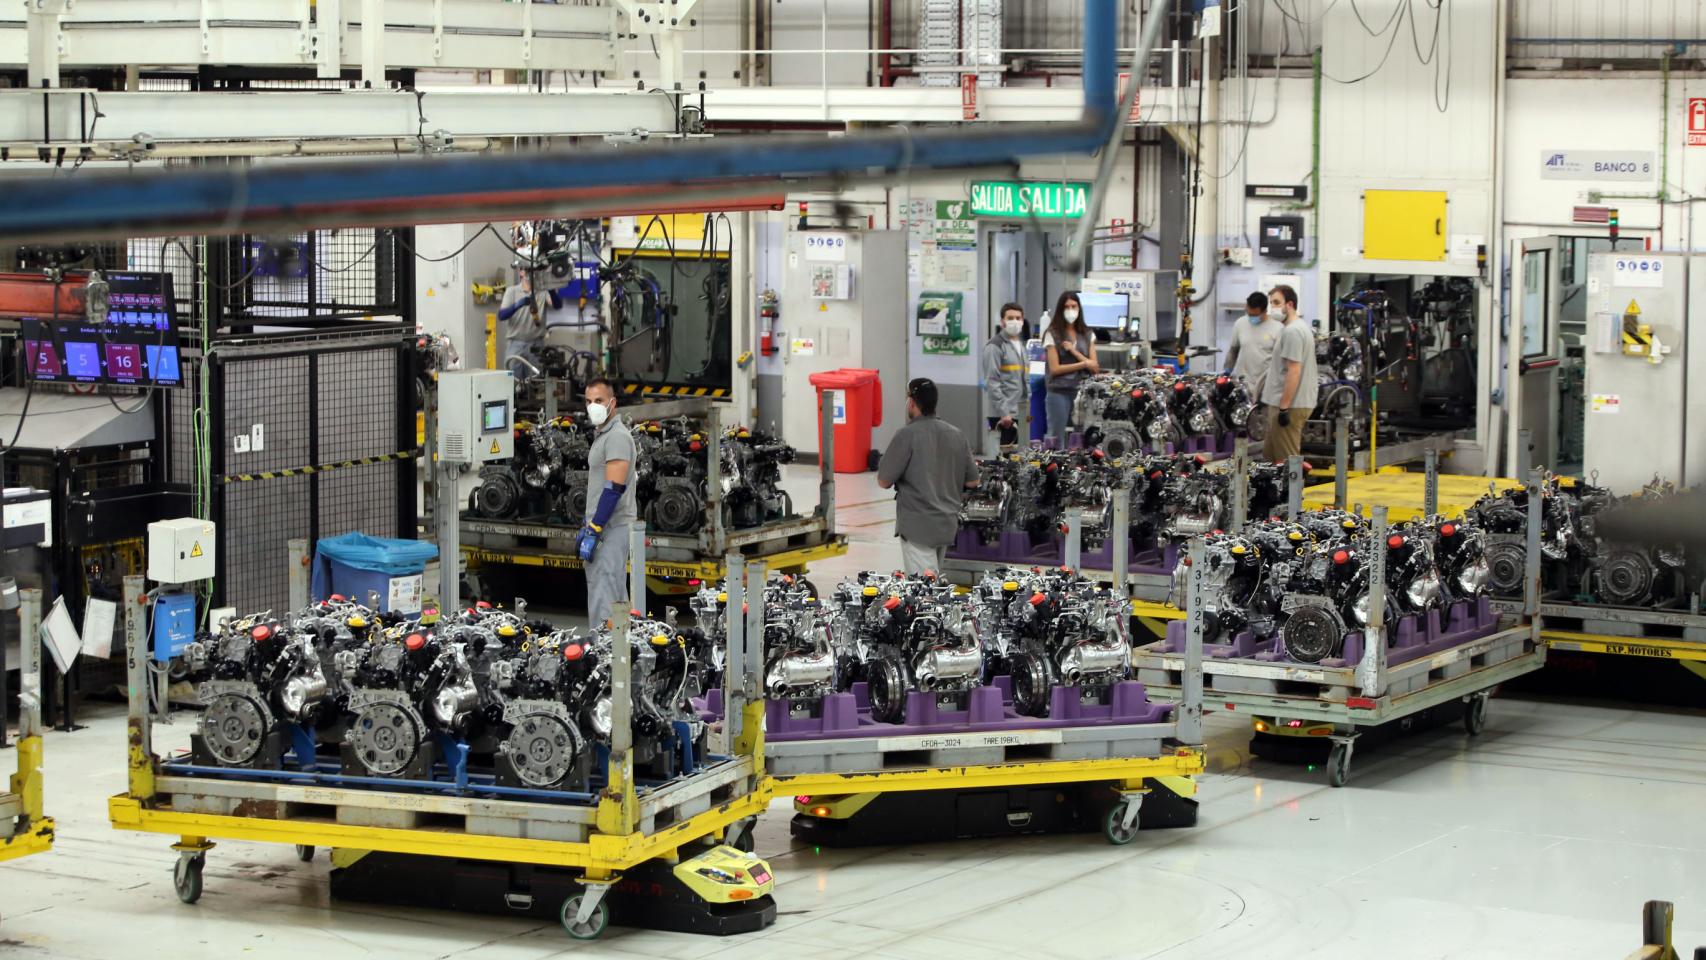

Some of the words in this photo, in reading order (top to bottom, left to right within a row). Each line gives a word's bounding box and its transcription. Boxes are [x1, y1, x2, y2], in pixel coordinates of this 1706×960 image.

[1594, 162, 1637, 173] BANCO
[1642, 164, 1650, 173] 8
[971, 185, 1014, 213] SALIDA
[1019, 187, 1087, 214] SALIDA
[39, 352, 48, 365] 5
[79, 353, 88, 366] 5
[115, 355, 132, 368] 16
[161, 357, 168, 369] 1
[1194, 570, 1202, 635] 31924
[127, 607, 136, 669] 19675
[1605, 644, 1672, 658] EXP.MOTORES
[984, 737, 998, 745] TARE
